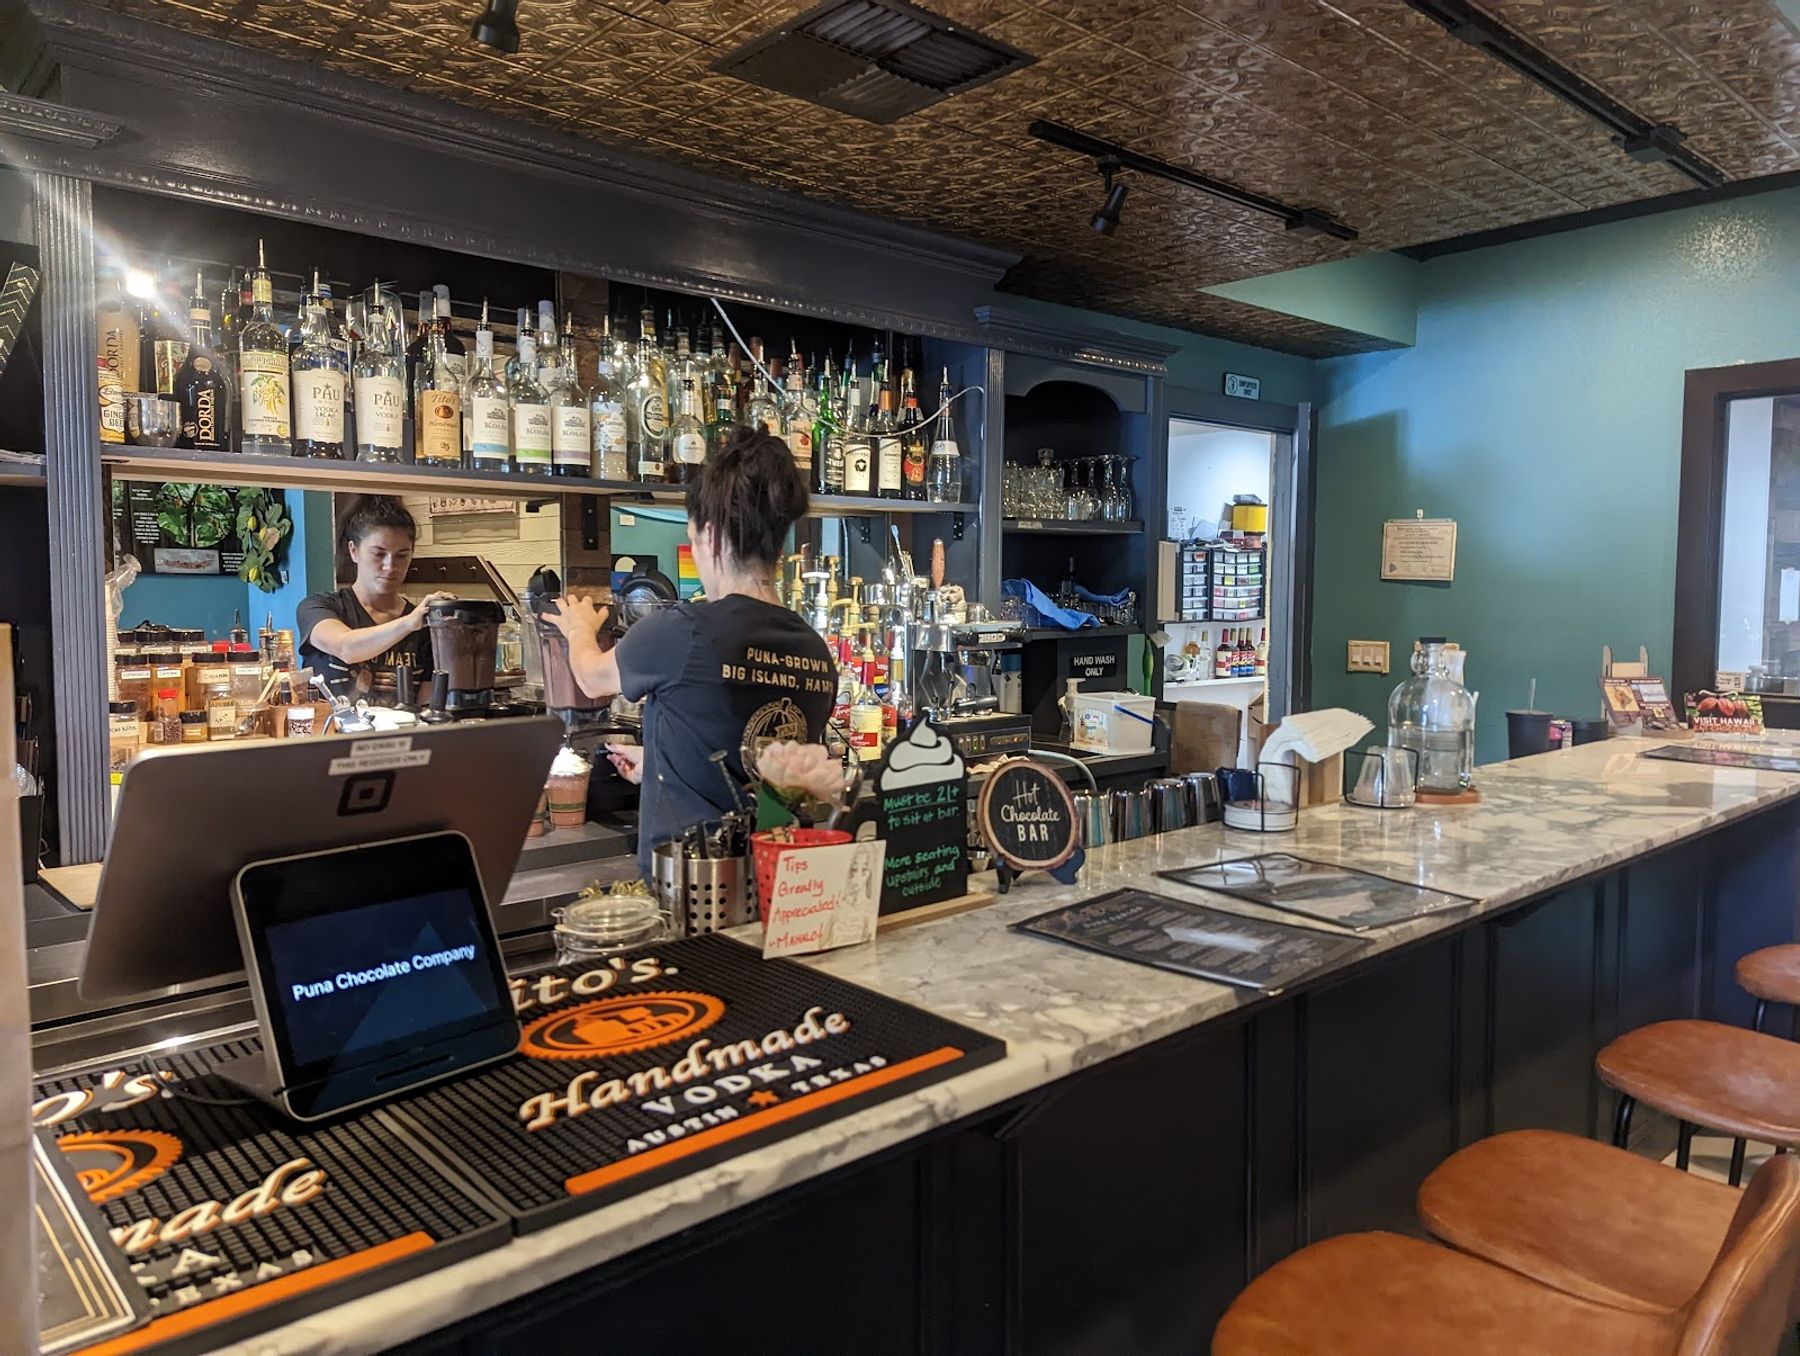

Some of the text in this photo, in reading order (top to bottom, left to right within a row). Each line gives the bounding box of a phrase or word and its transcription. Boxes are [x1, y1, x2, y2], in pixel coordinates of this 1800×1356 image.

[197, 389, 212, 442] DORDA
[746, 646, 829, 674] PUNA-GROWN
[1073, 655, 1116, 667] HAND WASH
[721, 663, 746, 681] BIG
[751, 668, 801, 691] ISLAND,
[1084, 667, 1104, 677] ONLY
[1693, 716, 1718, 725] VISIT
[883, 796, 913, 812] Must
[915, 792, 932, 804] be
[1012, 779, 1041, 809] Hot
[888, 815, 902, 831] to
[902, 810, 920, 825] sit
[1000, 804, 1060, 822] Chocolate
[1017, 823, 1049, 842] BAR
[783, 855, 809, 875] Tips
[885, 853, 912, 872] More
[885, 860, 956, 888] upstairs and
[777, 878, 825, 898] Greatly
[902, 876, 943, 898] outside
[292, 943, 477, 1001] Puna Chocolate Company
[509, 956, 680, 1012] ito's.
[518, 1006, 850, 1133] Handmade
[641, 1054, 823, 1116] VODKA
[626, 1054, 888, 1154] AUSTIN TEXAS
